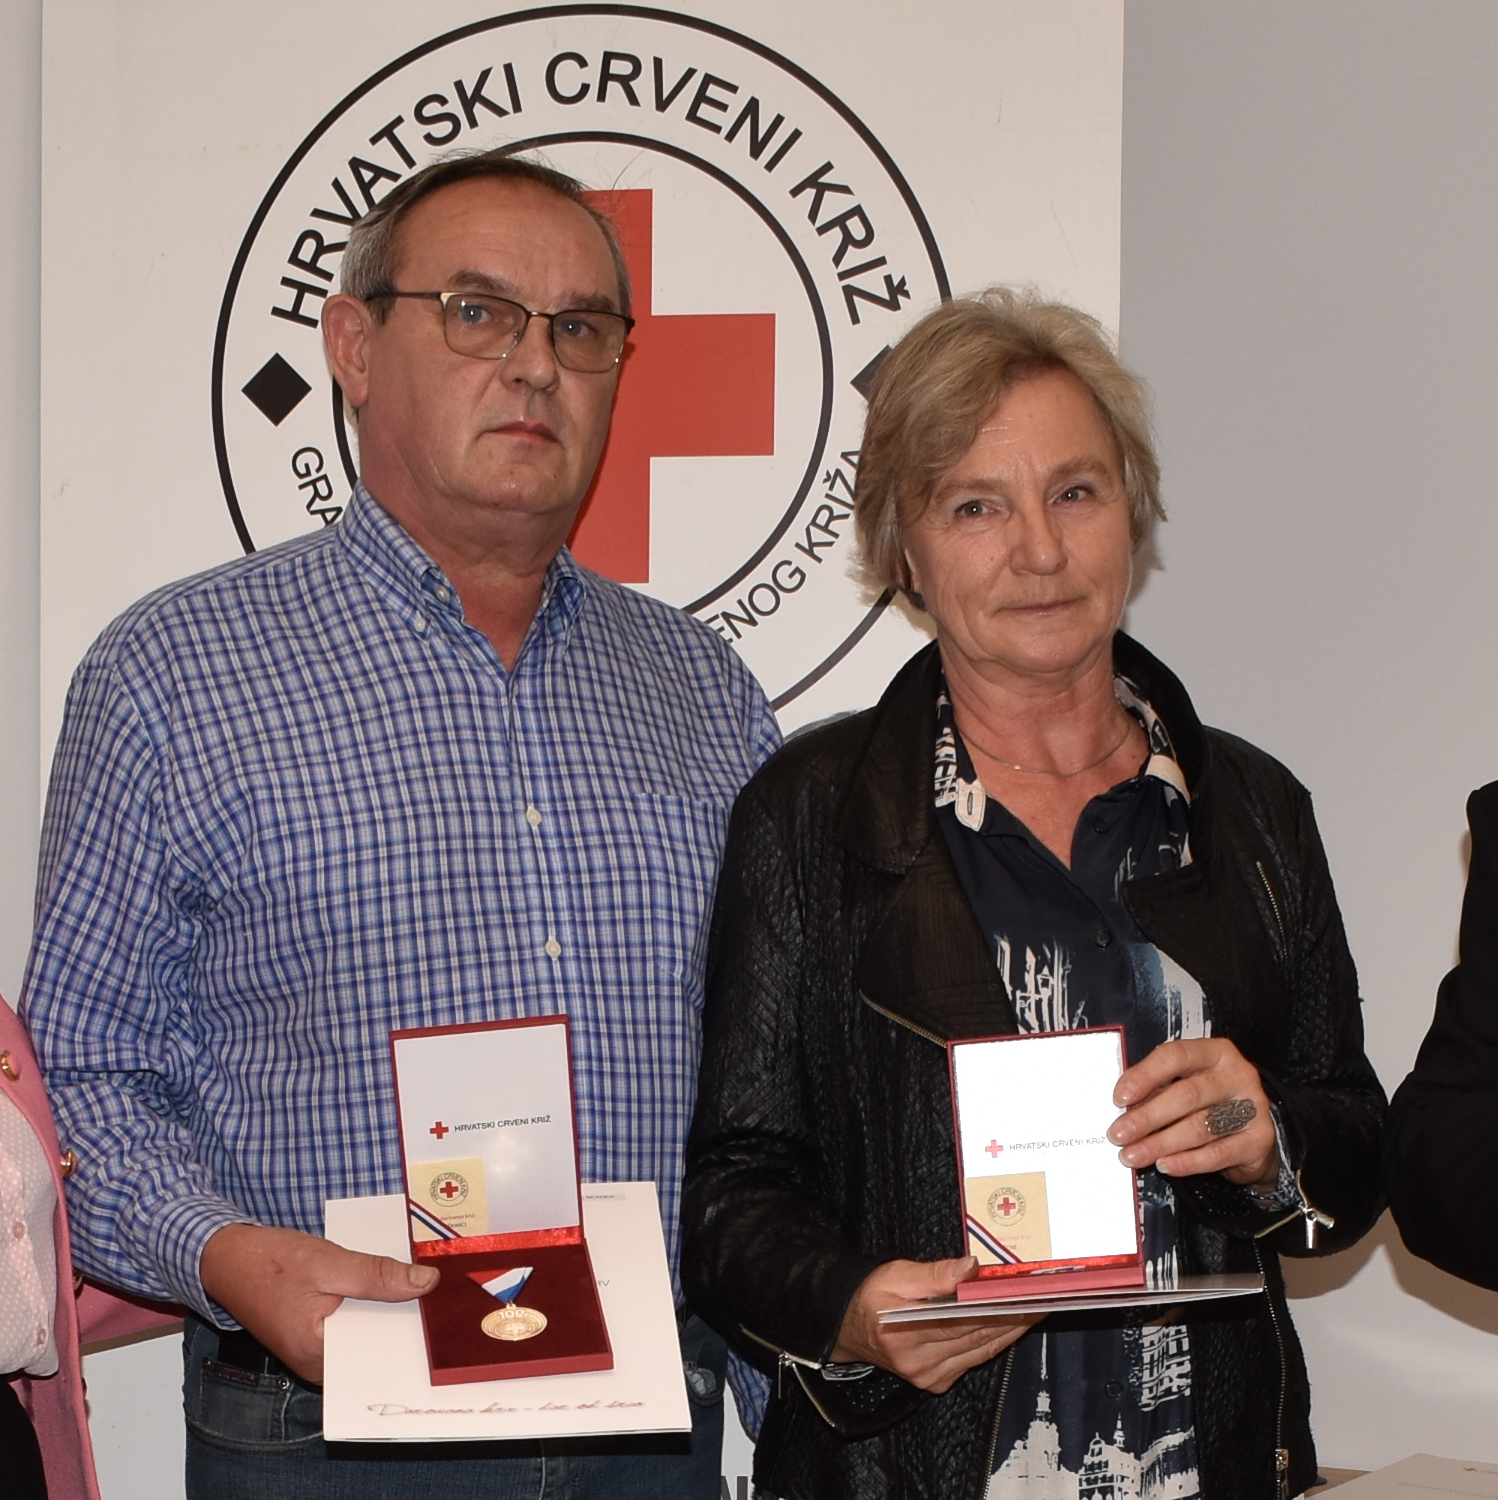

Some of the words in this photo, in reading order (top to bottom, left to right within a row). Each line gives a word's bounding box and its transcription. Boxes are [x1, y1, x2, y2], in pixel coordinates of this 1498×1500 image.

[270, 61, 523, 329] HRVATSKI
[545, 50, 803, 173] CRVENI
[789, 160, 911, 326] KRIŽ
[291, 446, 344, 526] GRA
[454, 1121, 496, 1133] HRVATSKI
[497, 1118, 529, 1128] CRVENI
[531, 1114, 552, 1123] KRIŽ
[1009, 1141, 1050, 1151] HRVATSKI
[1052, 1139, 1084, 1148] CRVENI
